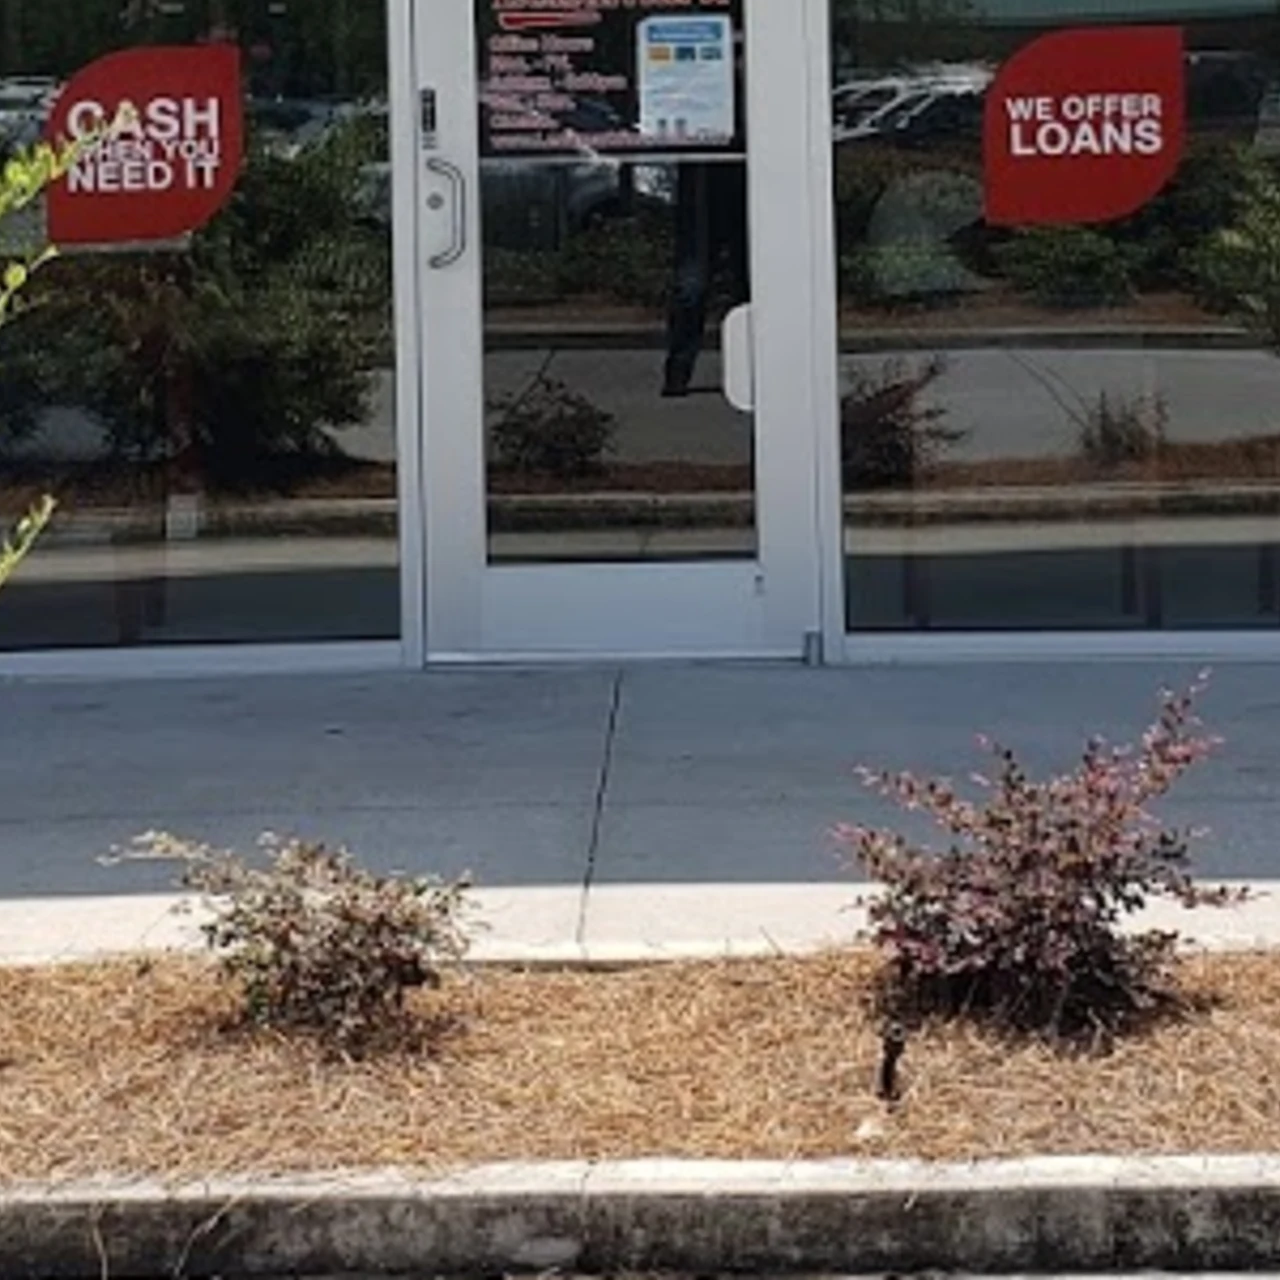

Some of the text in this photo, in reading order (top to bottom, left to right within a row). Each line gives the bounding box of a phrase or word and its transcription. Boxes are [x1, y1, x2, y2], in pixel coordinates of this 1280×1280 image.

[67, 96, 219, 140] CASH
[1005, 93, 1162, 121] WE OFFER
[162, 137, 219, 160] YOU
[1010, 120, 1163, 155] LOANS
[68, 158, 219, 193] NEED IT
